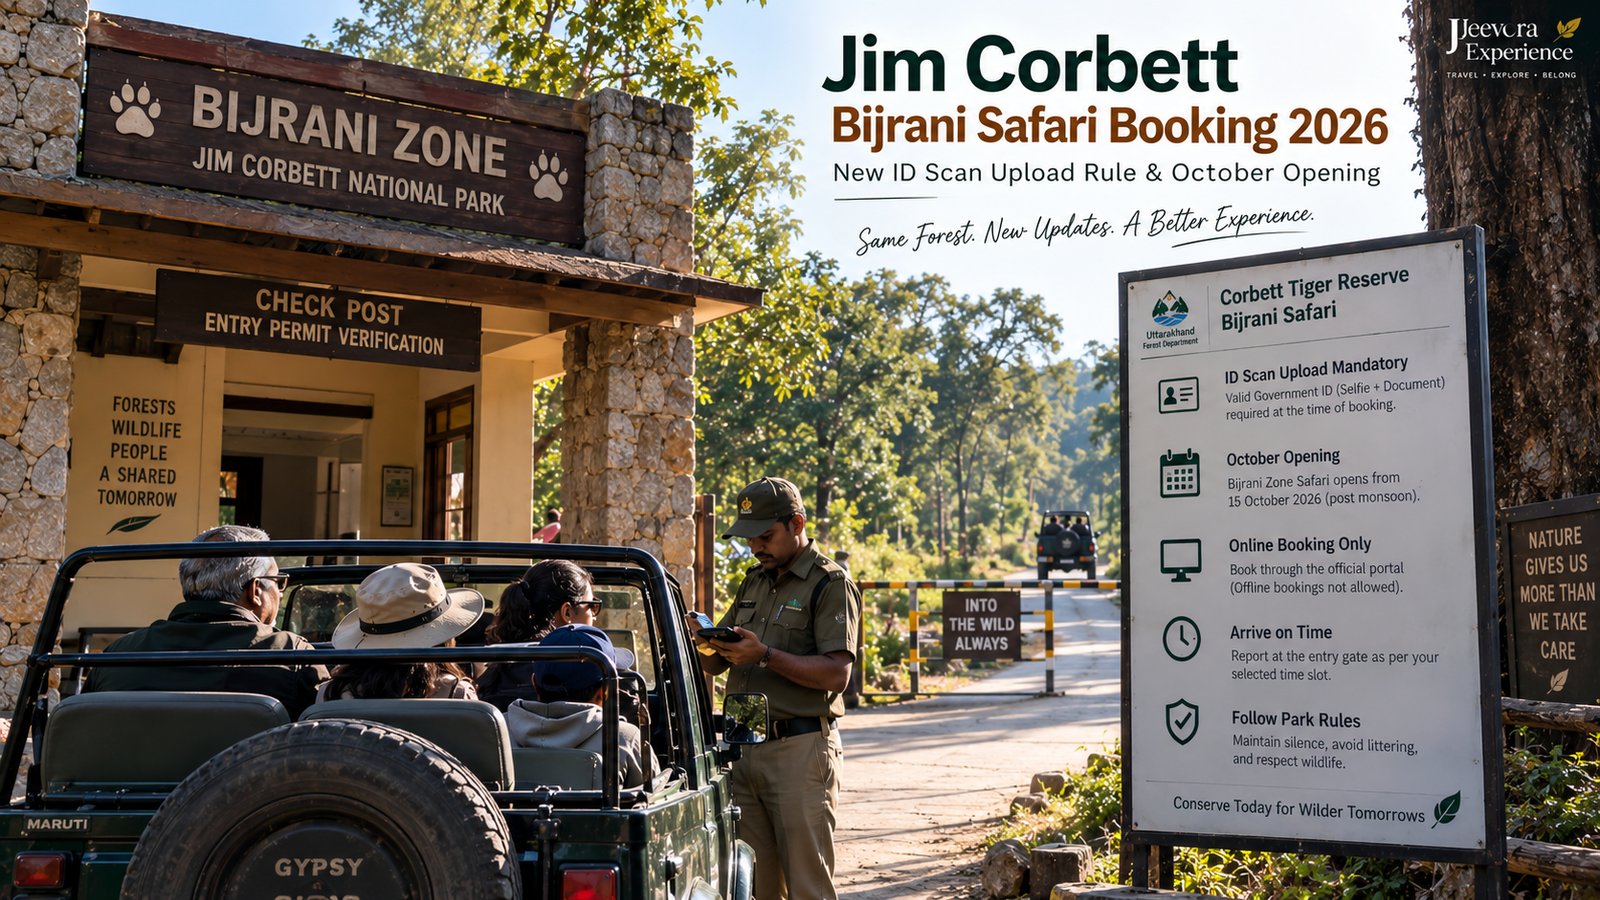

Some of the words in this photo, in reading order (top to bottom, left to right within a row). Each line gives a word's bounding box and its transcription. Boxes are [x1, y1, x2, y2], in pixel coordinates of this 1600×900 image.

[193, 85, 378, 156] BIJRANI
[394, 119, 507, 178] ZONE
[192, 147, 233, 173] JIM
[242, 154, 341, 190] CORBETT
[349, 170, 448, 207] NATIONAL
[456, 187, 505, 216] PARK
[1220, 283, 1284, 305] Corbett
[1288, 278, 1333, 299] Tiger
[1338, 269, 1409, 290] Reserve
[256, 289, 335, 318] CHECK
[347, 299, 403, 326] POST
[1222, 307, 1277, 333] Bijrani
[1283, 300, 1336, 323] Safari
[205, 312, 262, 336] ENTRY
[270, 319, 332, 343] PERMIT
[339, 327, 443, 356] VERIFICATION
[1146, 326, 1195, 340] Uttarakhand
[1225, 371, 1239, 384] ID
[1243, 369, 1275, 383] Scan
[1280, 361, 1328, 382] Upload
[1332, 357, 1408, 374] Mandatory
[1225, 391, 1251, 403] Valid
[1254, 387, 1318, 401] Government
[1322, 385, 1333, 396] ID
[1336, 382, 1370, 397] (Selfie
[1373, 383, 1380, 391] +
[1384, 376, 1445, 392] Document)
[113, 396, 175, 415] FORESTS
[1226, 407, 1270, 422] required
[1273, 407, 1284, 417] at
[1286, 405, 1304, 416] the
[1307, 404, 1331, 415] time
[1334, 401, 1346, 413] of
[1349, 399, 1396, 413] booking.
[112, 419, 181, 438] WILDLIFE
[111, 442, 167, 461] PEOPLE
[1227, 451, 1280, 466] October
[1284, 448, 1340, 467] Opening
[99, 465, 110, 481] A
[117, 466, 176, 484] SHARED
[1228, 477, 1262, 492] Bijrani
[1265, 476, 1293, 488] Zone
[1297, 474, 1329, 487] Safari
[1333, 475, 1369, 488] opens
[1372, 471, 1400, 484] from
[97, 489, 177, 507] TOMORROW
[1229, 495, 1241, 507] 15
[1244, 494, 1290, 507] October
[1293, 493, 1322, 505] 2026
[1325, 492, 1355, 507] (post
[1358, 489, 1420, 503] monsoon).
[1229, 538, 1273, 552] Online
[1278, 537, 1335, 554] Booking
[1339, 536, 1371, 554] Only
[1529, 526, 1582, 549] NATURE
[1230, 563, 1257, 575] Book
[1260, 563, 1303, 578] through
[1306, 563, 1325, 575] the
[1328, 562, 1366, 574] official
[1369, 561, 1404, 577] portal
[1526, 556, 1564, 576] GIVES
[1569, 554, 1588, 572] US
[1230, 581, 1270, 596] (Offline
[1274, 581, 1324, 596] bookings
[1328, 582, 1347, 593] not
[1350, 580, 1403, 595] allowed).
[1520, 584, 1555, 603] MORE
[1559, 582, 1595, 602] THAN
[965, 598, 997, 612] INTO
[949, 617, 975, 631] THE
[980, 617, 1015, 631] WILD
[1529, 612, 1549, 630] WE
[1553, 612, 1587, 630] TAKE
[1230, 625, 1271, 639] Arrive
[1275, 628, 1293, 639] on
[1296, 625, 1332, 639] Time
[955, 636, 1008, 651] ALWAYS
[1541, 641, 1576, 660] CARE
[1231, 649, 1269, 664] Report
[1272, 651, 1283, 662] at
[1286, 650, 1305, 662] the
[1308, 651, 1339, 665] entry
[1342, 651, 1368, 665] gate
[1371, 653, 1385, 663] as
[1389, 653, 1409, 666] per
[1412, 653, 1439, 666] your
[1231, 668, 1277, 680] selected
[1280, 668, 1304, 680] time
[1307, 668, 1331, 681] slot.
[1232, 710, 1277, 725] Follow
[1282, 712, 1314, 727] Park
[1319, 713, 1361, 728] Rules
[1233, 734, 1281, 748] Maintain
[1284, 736, 1328, 752] silence,
[1332, 738, 1364, 751] avoid
[1368, 739, 1418, 756] littering,
[1233, 752, 1253, 765] and
[1256, 756, 1298, 769] respect
[1301, 755, 1346, 769] wildlife.
[1173, 796, 1230, 812] Conserve
[1234, 799, 1272, 817] Today
[1276, 801, 1295, 815] for
[1299, 803, 1343, 818] Wilder
[1347, 805, 1425, 823] Tomorrows
[27, 819, 87, 829] MARUTI
[275, 858, 363, 876] GYPSY
